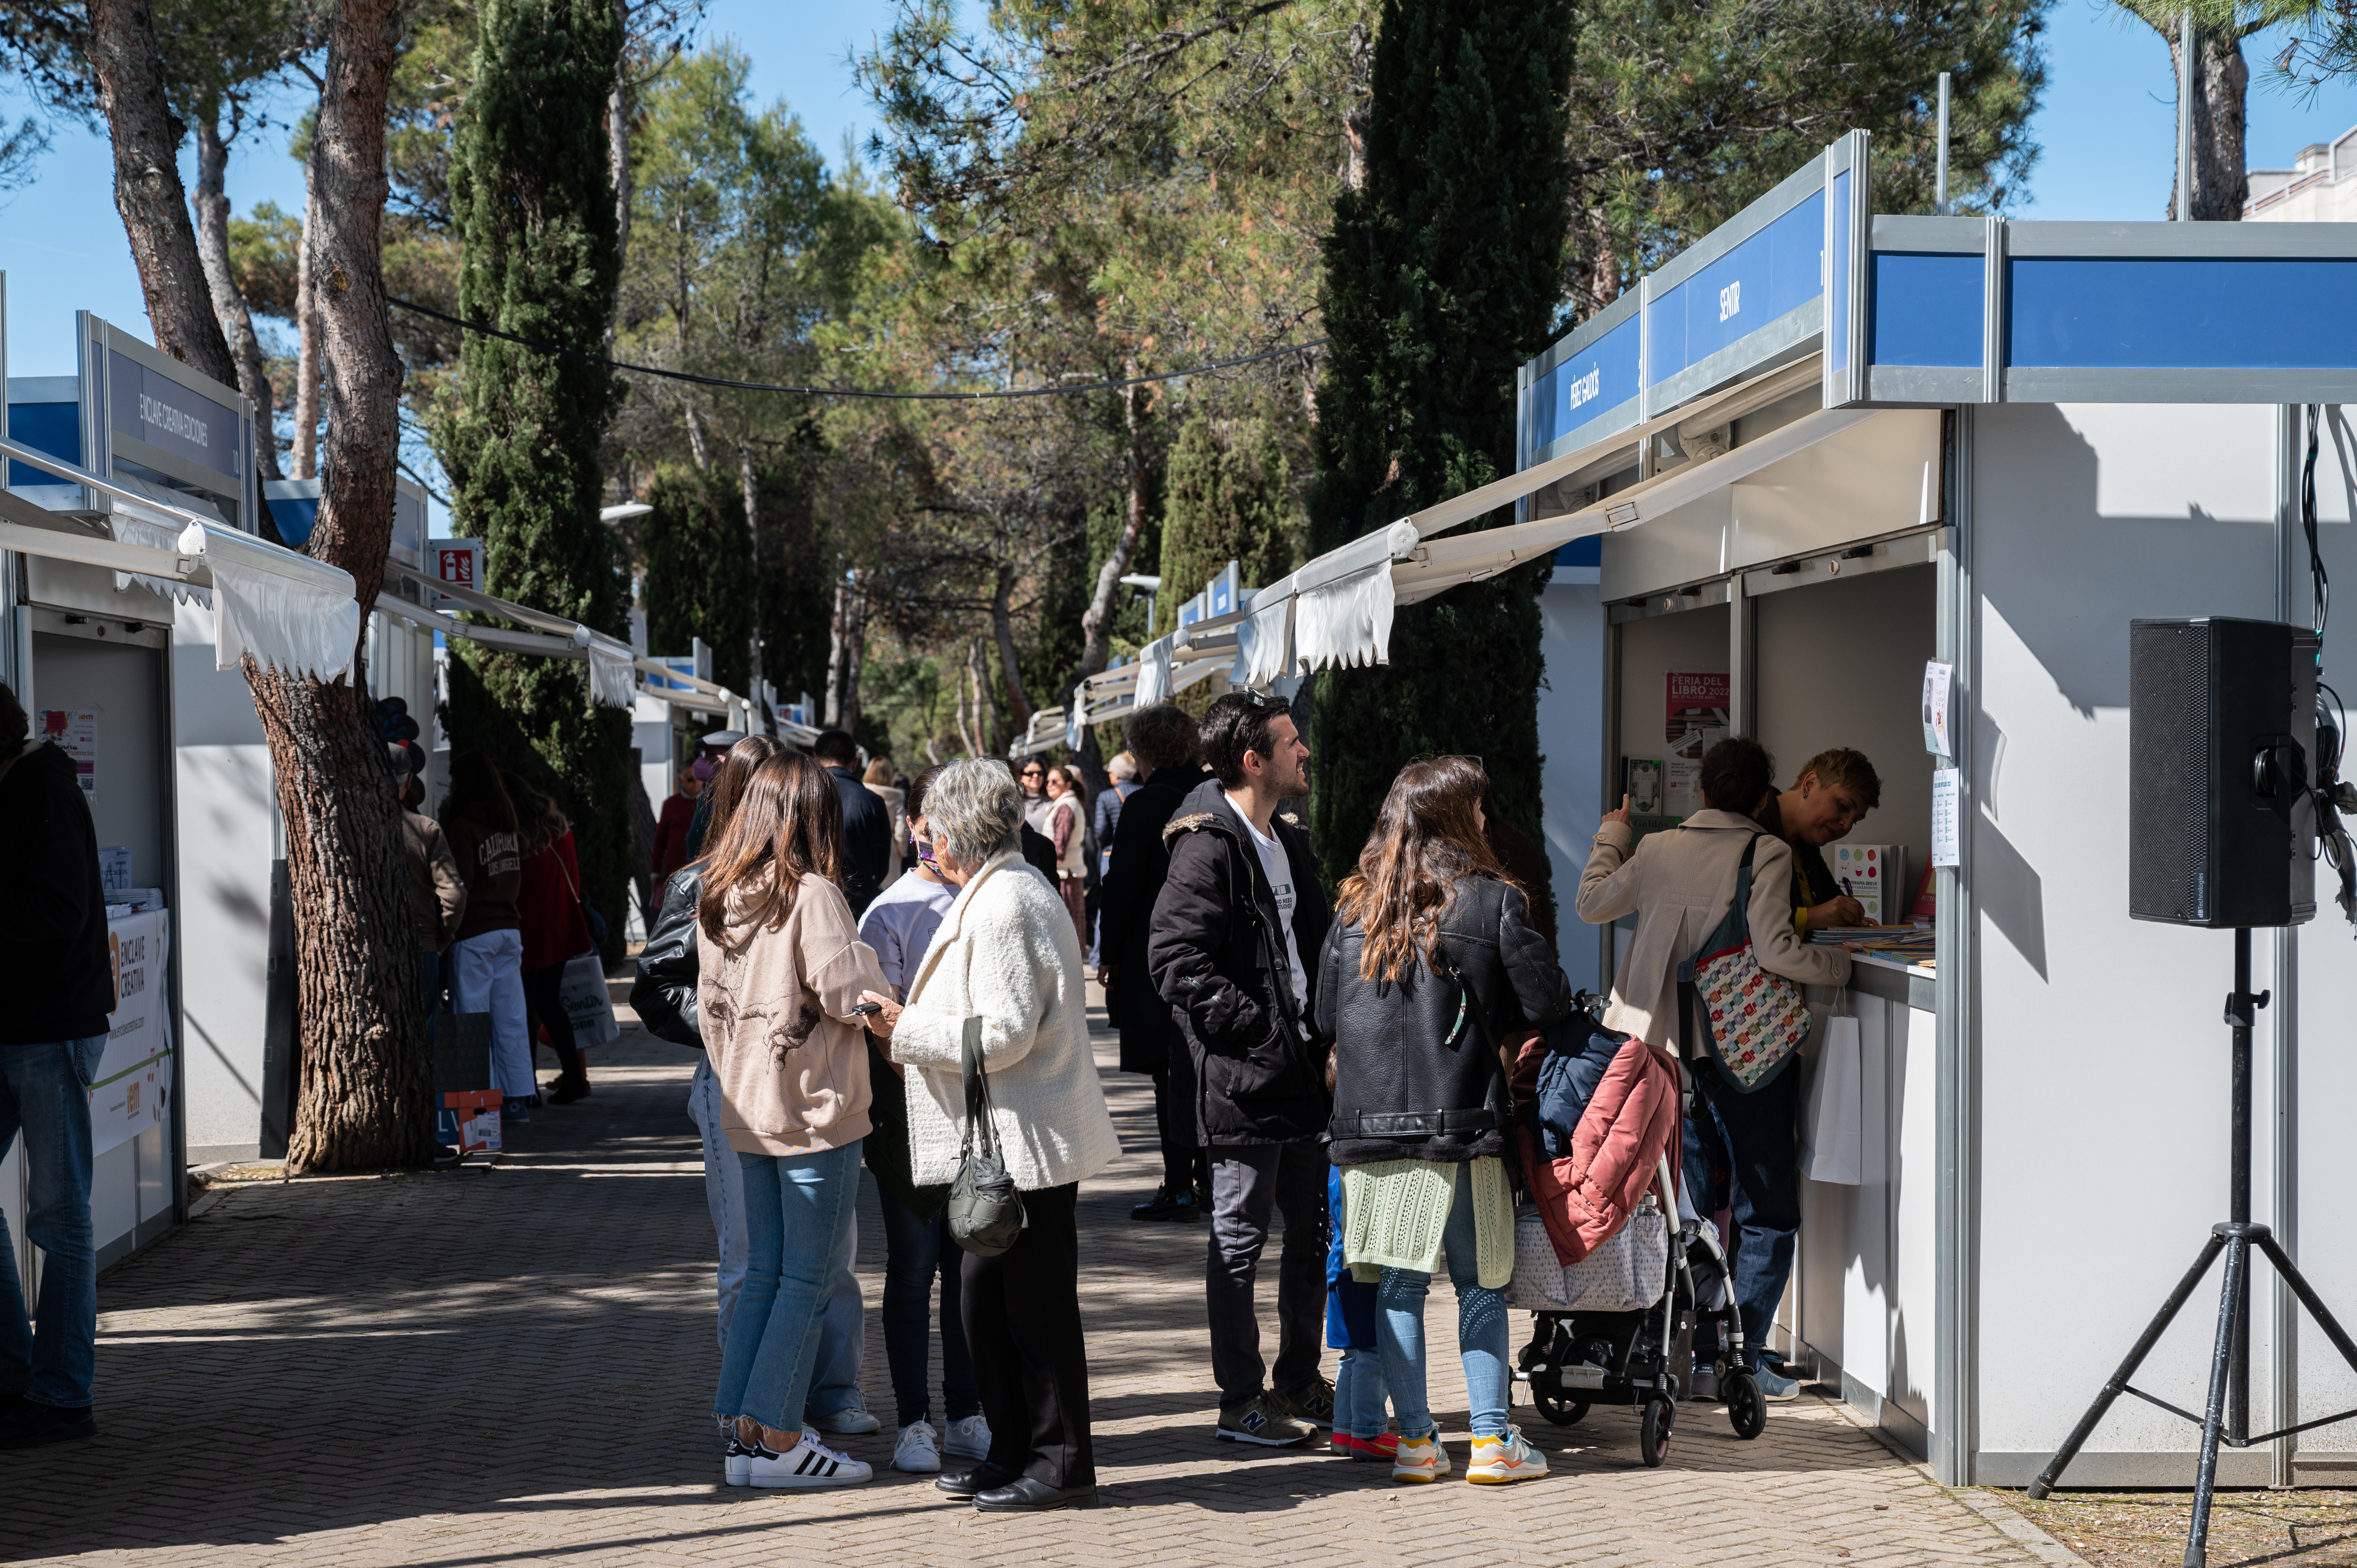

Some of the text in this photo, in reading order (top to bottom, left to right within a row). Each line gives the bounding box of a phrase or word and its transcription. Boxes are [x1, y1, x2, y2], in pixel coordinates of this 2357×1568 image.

[1720, 280, 1740, 322] SENTIR
[1570, 361, 1599, 410] PÉREZ GALDÓS
[140, 393, 207, 447] ENCLAVE CREATIVA EDICIONES
[233, 450, 239, 474] 10
[1672, 685, 1707, 695] LIBRO
[1704, 677, 1723, 685] DEL
[1634, 820, 1668, 828] Galdós
[121, 936, 144, 967] ENCLAVE
[121, 967, 144, 999] CREATIVA
[562, 995, 603, 1013] Sentir
[127, 1081, 139, 1114] iem
